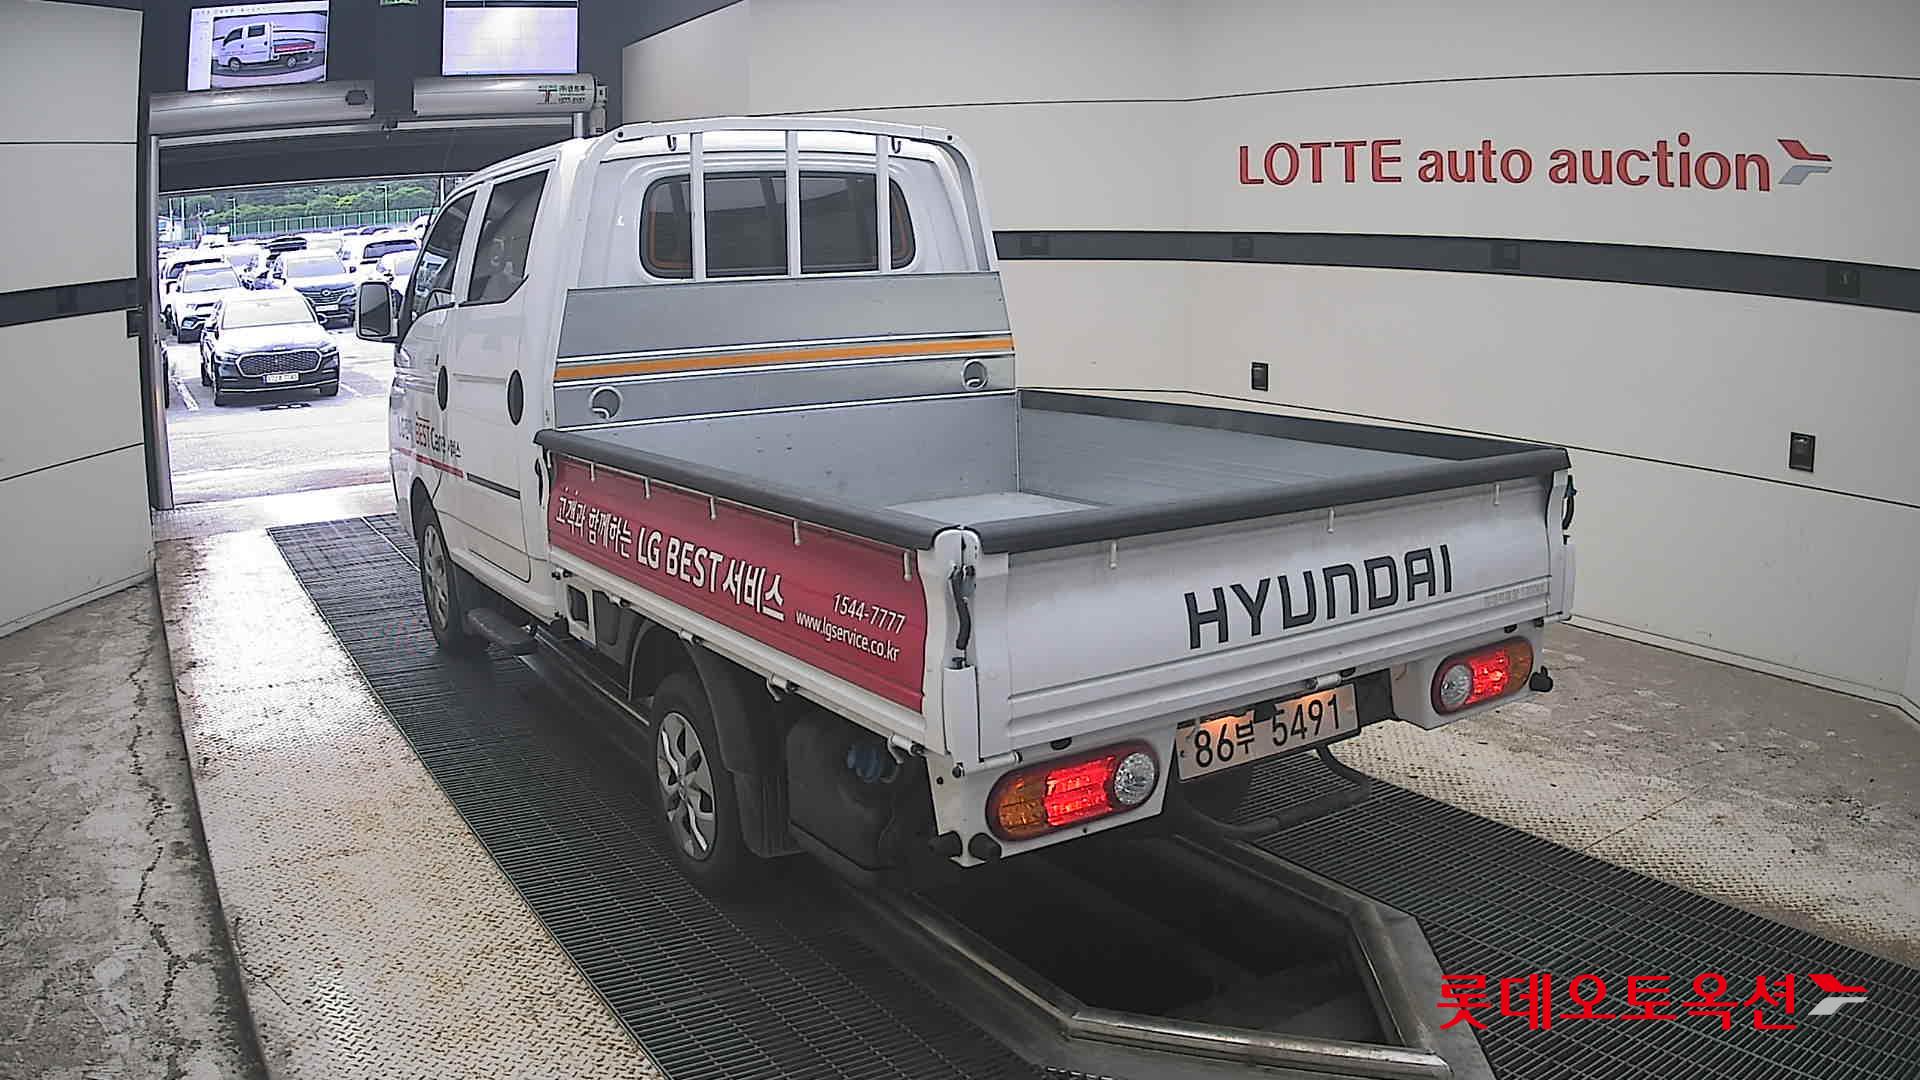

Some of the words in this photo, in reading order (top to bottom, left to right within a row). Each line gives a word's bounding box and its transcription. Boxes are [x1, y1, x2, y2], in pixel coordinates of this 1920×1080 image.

[1239, 138, 1402, 185] LOTTE
[1417, 139, 1533, 185] auto
[1548, 131, 1771, 191] auction
[556, 496, 586, 537] 고객과
[588, 507, 633, 559] 함께하는
[637, 527, 663, 570] LG
[666, 536, 722, 592] BEST
[722, 558, 785, 621] 서비스
[833, 593, 906, 635] 1544-7777
[1184, 544, 1452, 650] HYUNDAI
[795, 610, 900, 662] www.lgservice.co.kr
[1194, 722, 1256, 768] 86부
[1272, 694, 1340, 748] 5491
